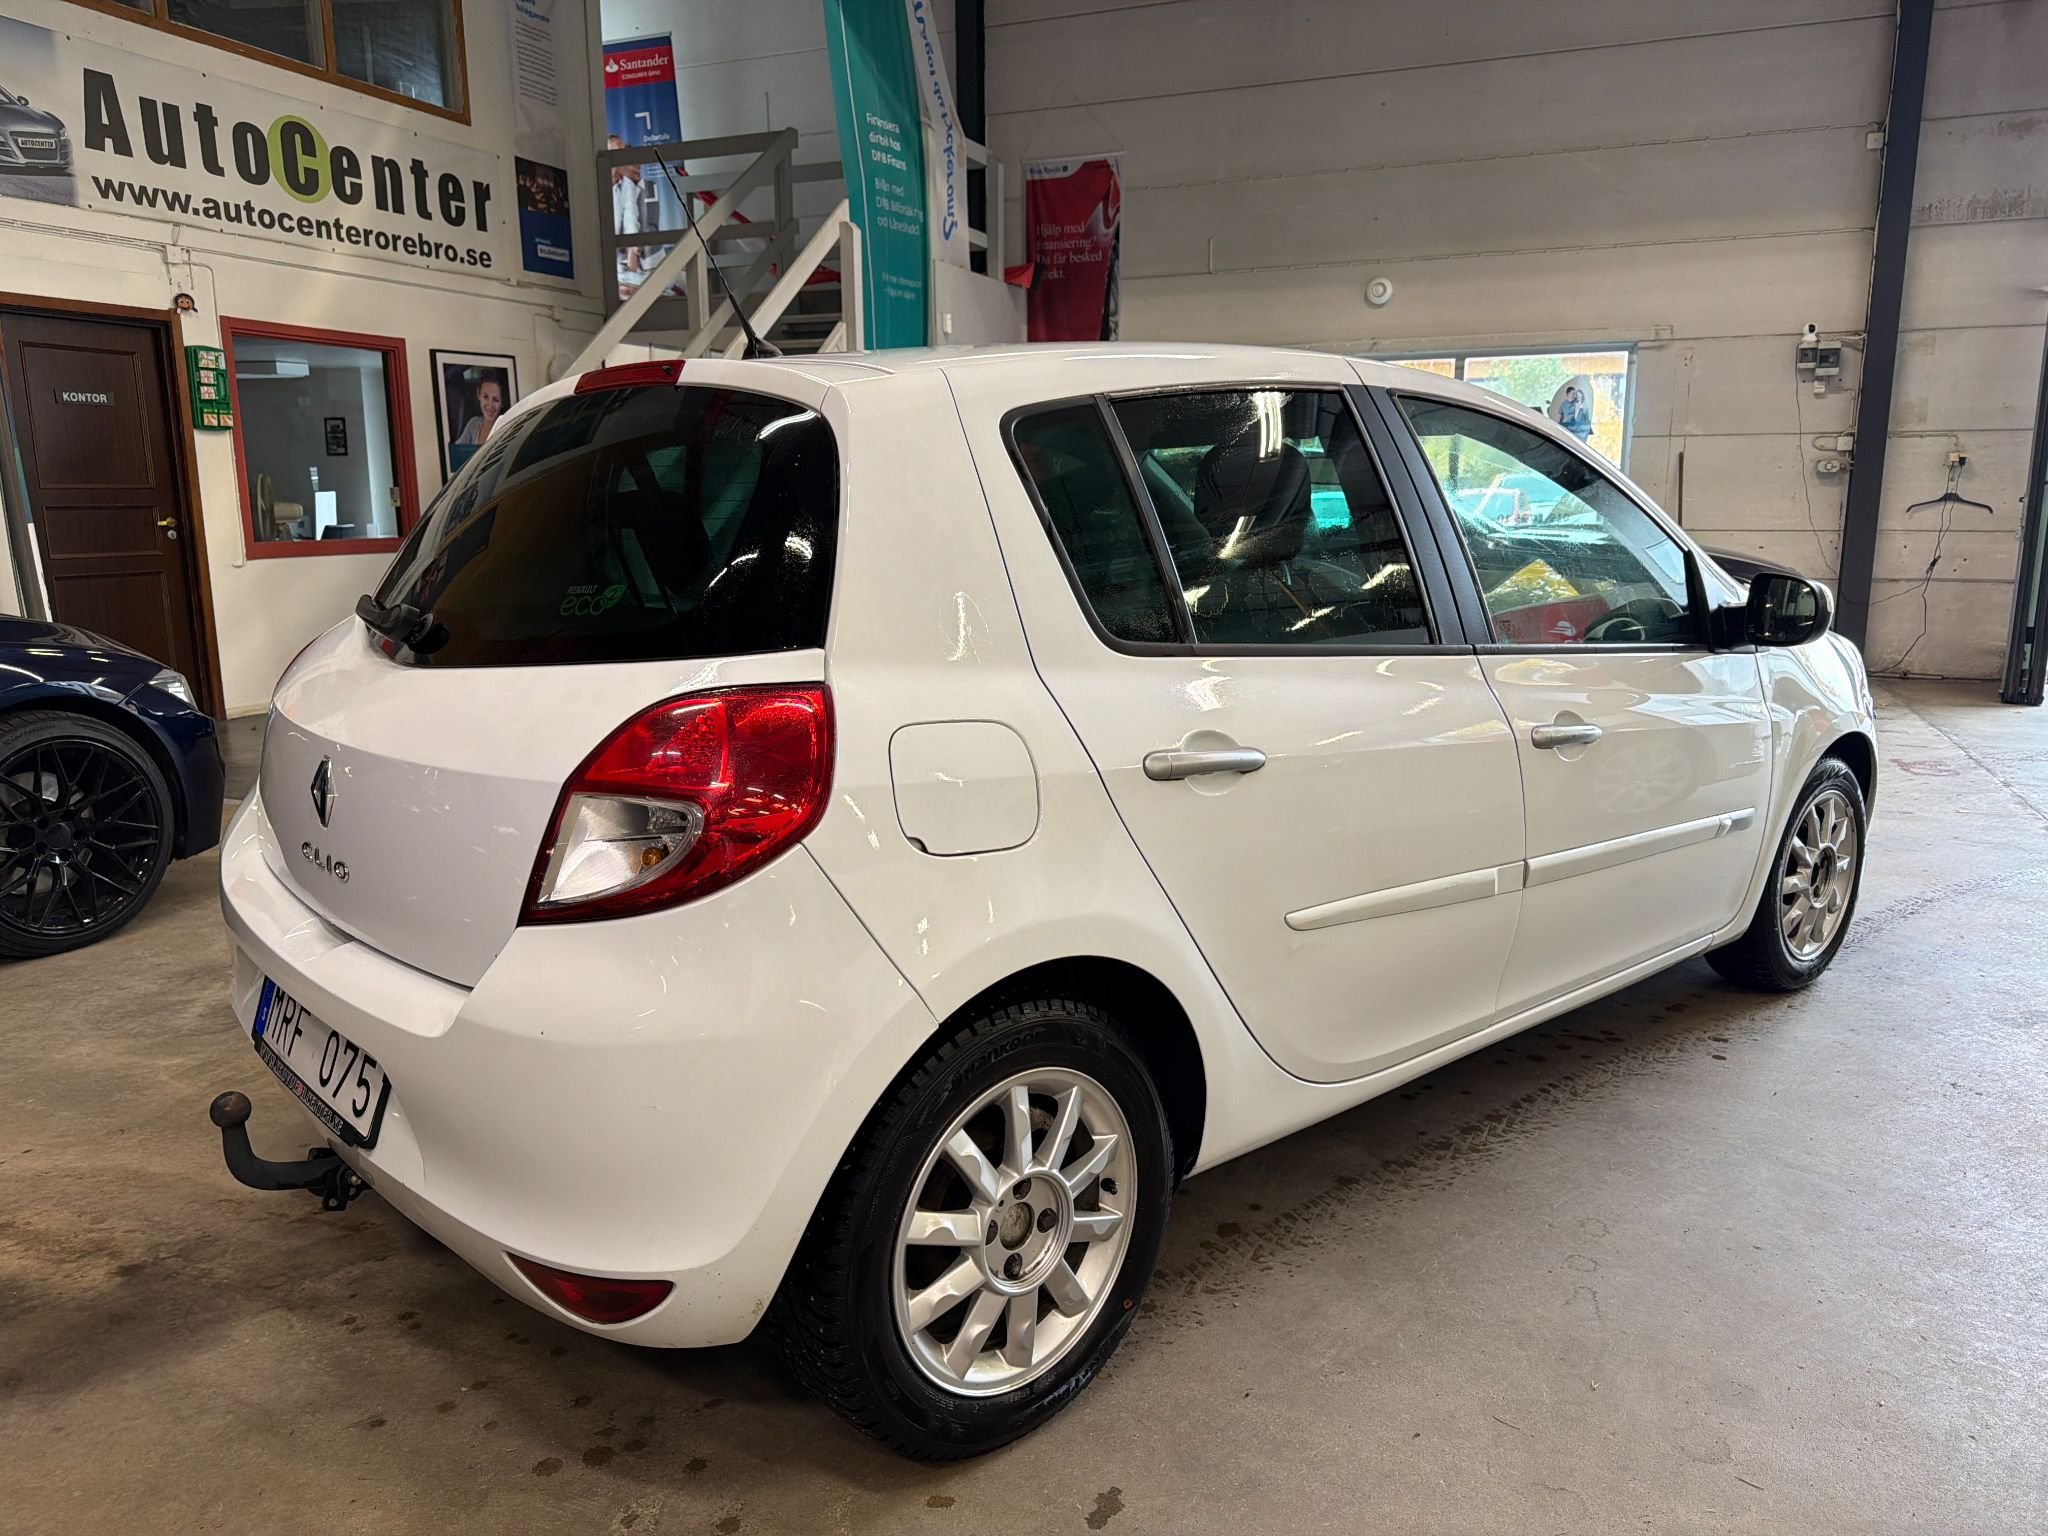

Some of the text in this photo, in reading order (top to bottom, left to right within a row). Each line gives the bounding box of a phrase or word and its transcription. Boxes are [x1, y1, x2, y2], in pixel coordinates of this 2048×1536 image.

[620, 54, 669, 71] Santander
[83, 67, 492, 233] AutoCenter
[92, 174, 493, 269] www.autocenterorebro.se
[1036, 221, 1085, 239] Hjälp med
[1054, 252, 1067, 264] får
[1069, 249, 1103, 264] besked
[62, 391, 108, 404] KONTOR
[567, 584, 599, 594] RENAULT
[301, 840, 350, 883] CLIO
[266, 985, 312, 1058] MRF
[318, 1028, 378, 1118] 075
